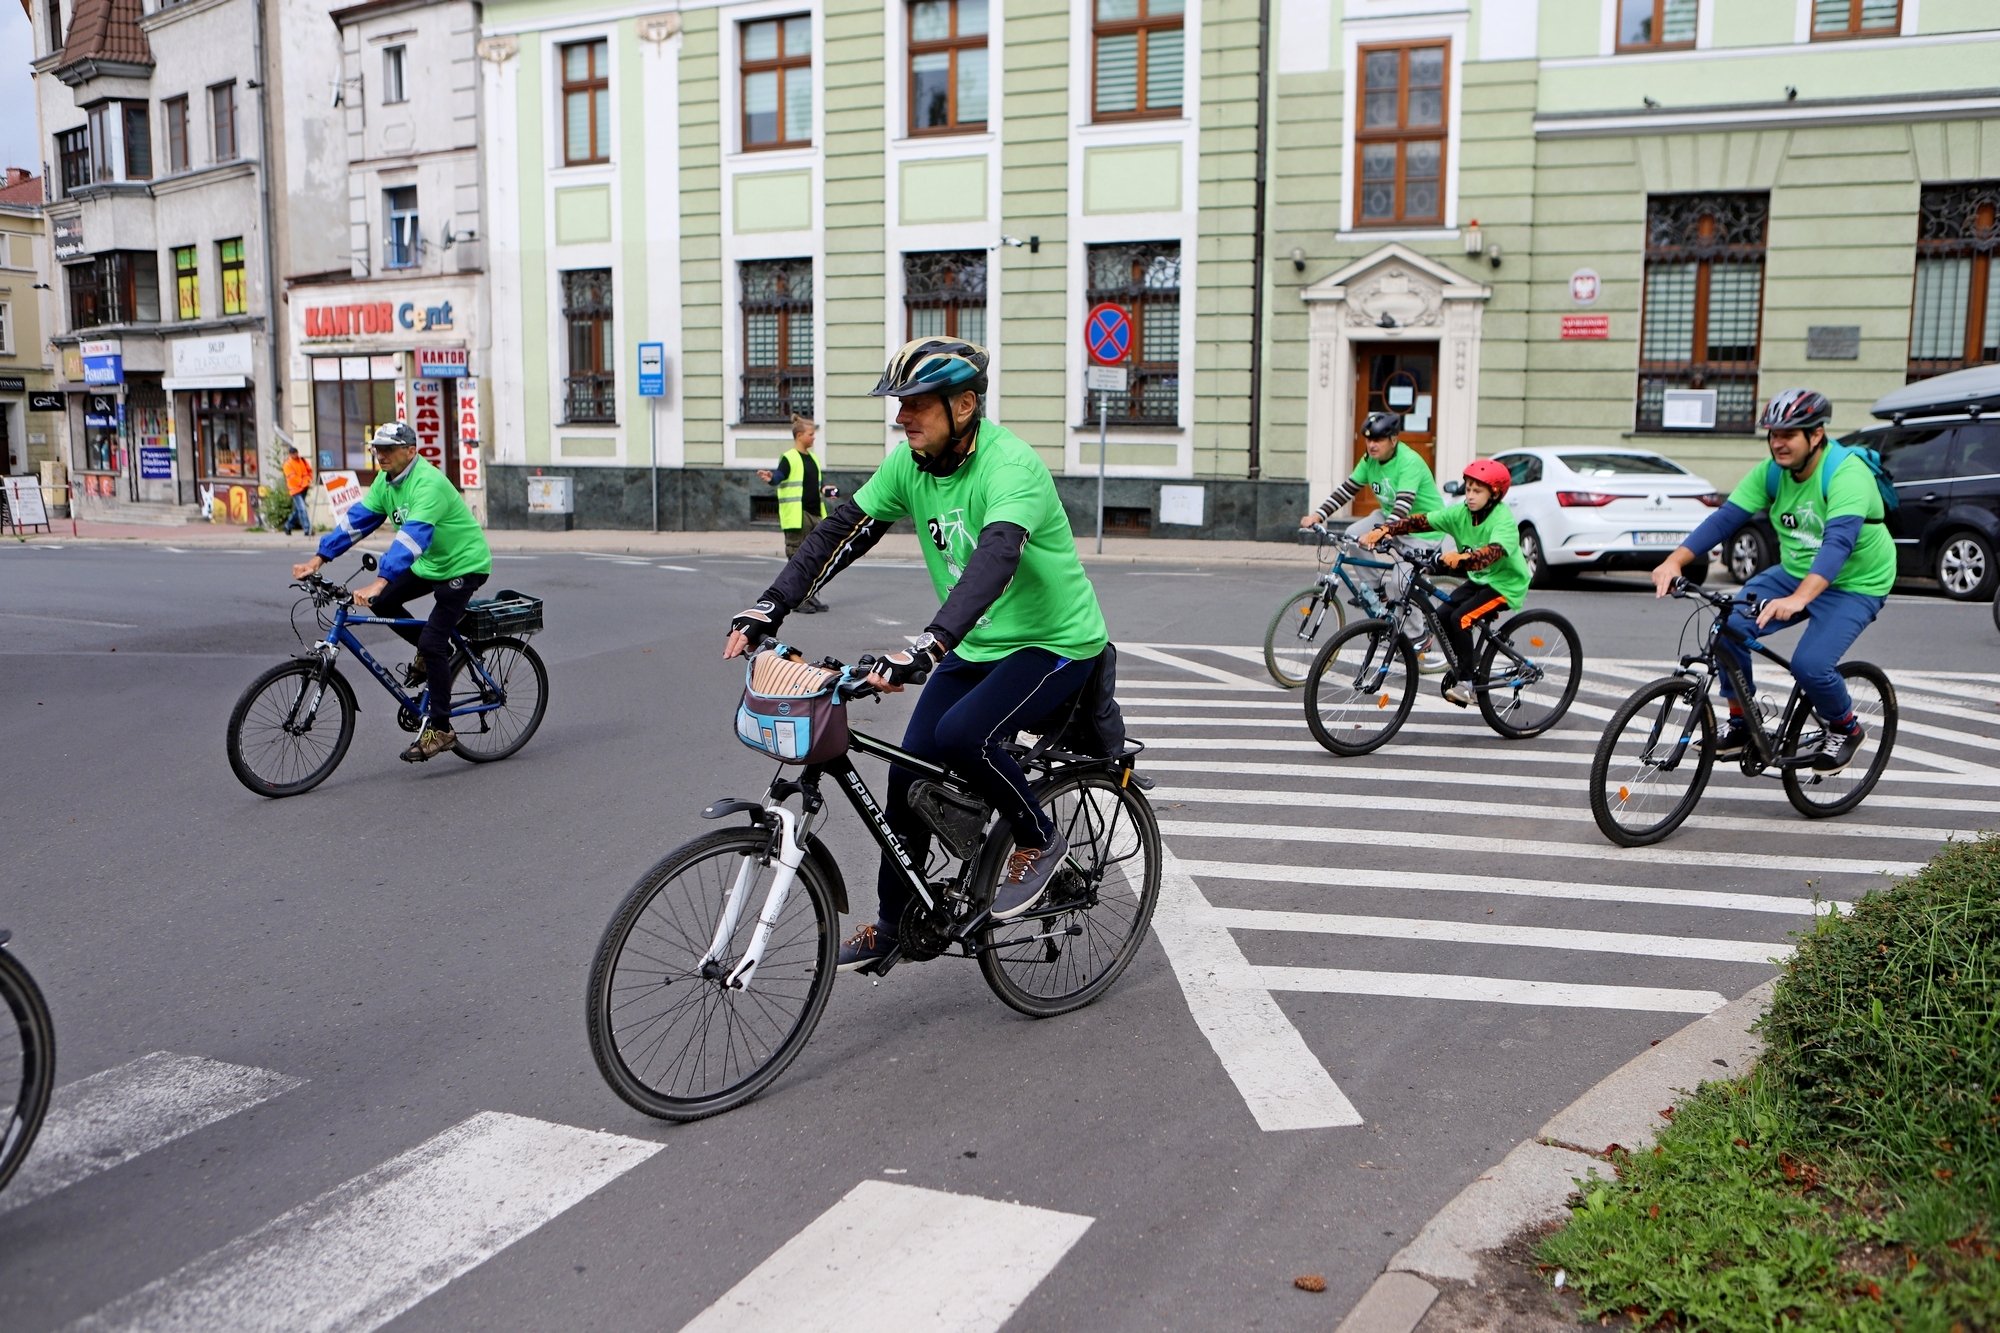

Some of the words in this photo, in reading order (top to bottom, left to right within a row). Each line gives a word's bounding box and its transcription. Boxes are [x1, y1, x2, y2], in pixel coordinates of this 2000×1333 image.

[305, 302, 393, 337] KANTOR
[398, 301, 453, 332] Cent
[422, 351, 464, 364] KANTOR
[414, 382, 439, 392] Cent
[416, 394, 441, 467] KANTO
[461, 397, 478, 486] KANTOR
[331, 486, 361, 506] KANTOR
[1373, 482, 1380, 493] 21
[1782, 514, 1796, 527] 21
[929, 522, 945, 546] 21
[847, 770, 913, 867] spartacus
